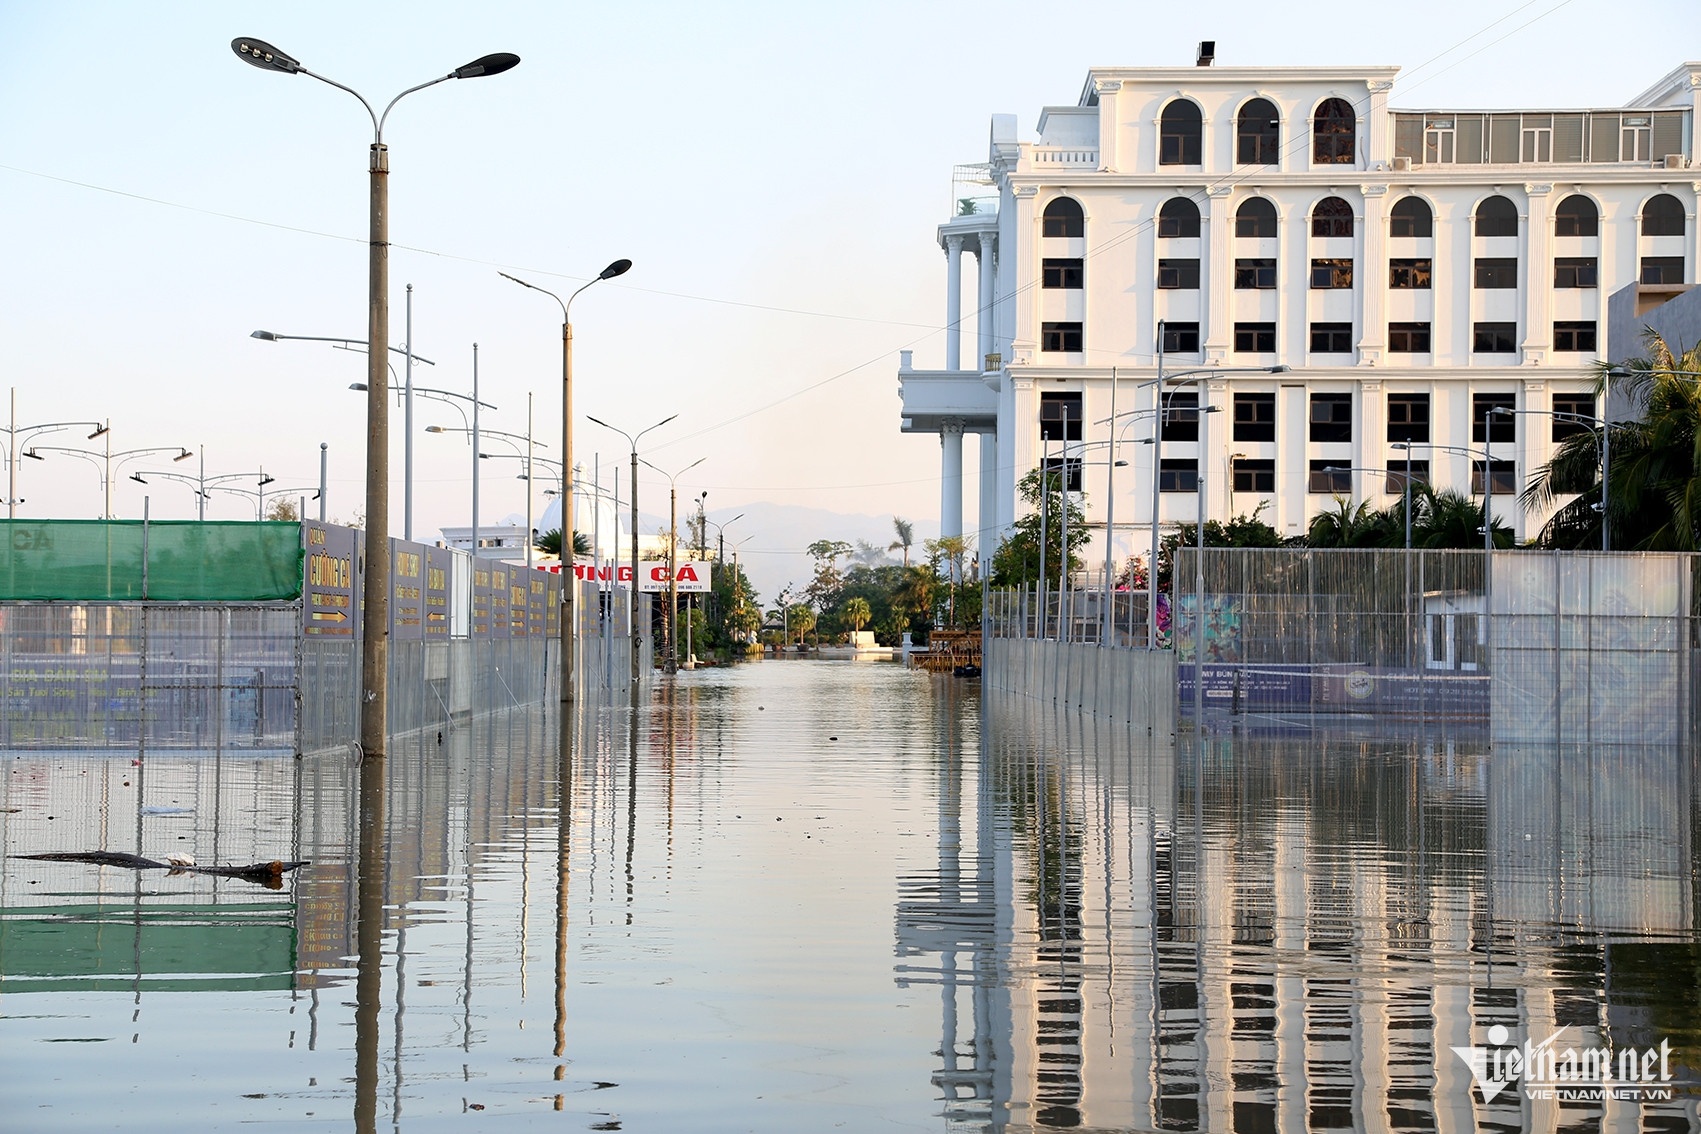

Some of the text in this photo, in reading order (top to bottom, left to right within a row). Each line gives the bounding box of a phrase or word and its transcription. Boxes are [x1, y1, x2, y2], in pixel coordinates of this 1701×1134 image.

[309, 525, 326, 547] QUÁN
[340, 553, 351, 589] CÁ
[651, 563, 699, 582] CÁ
